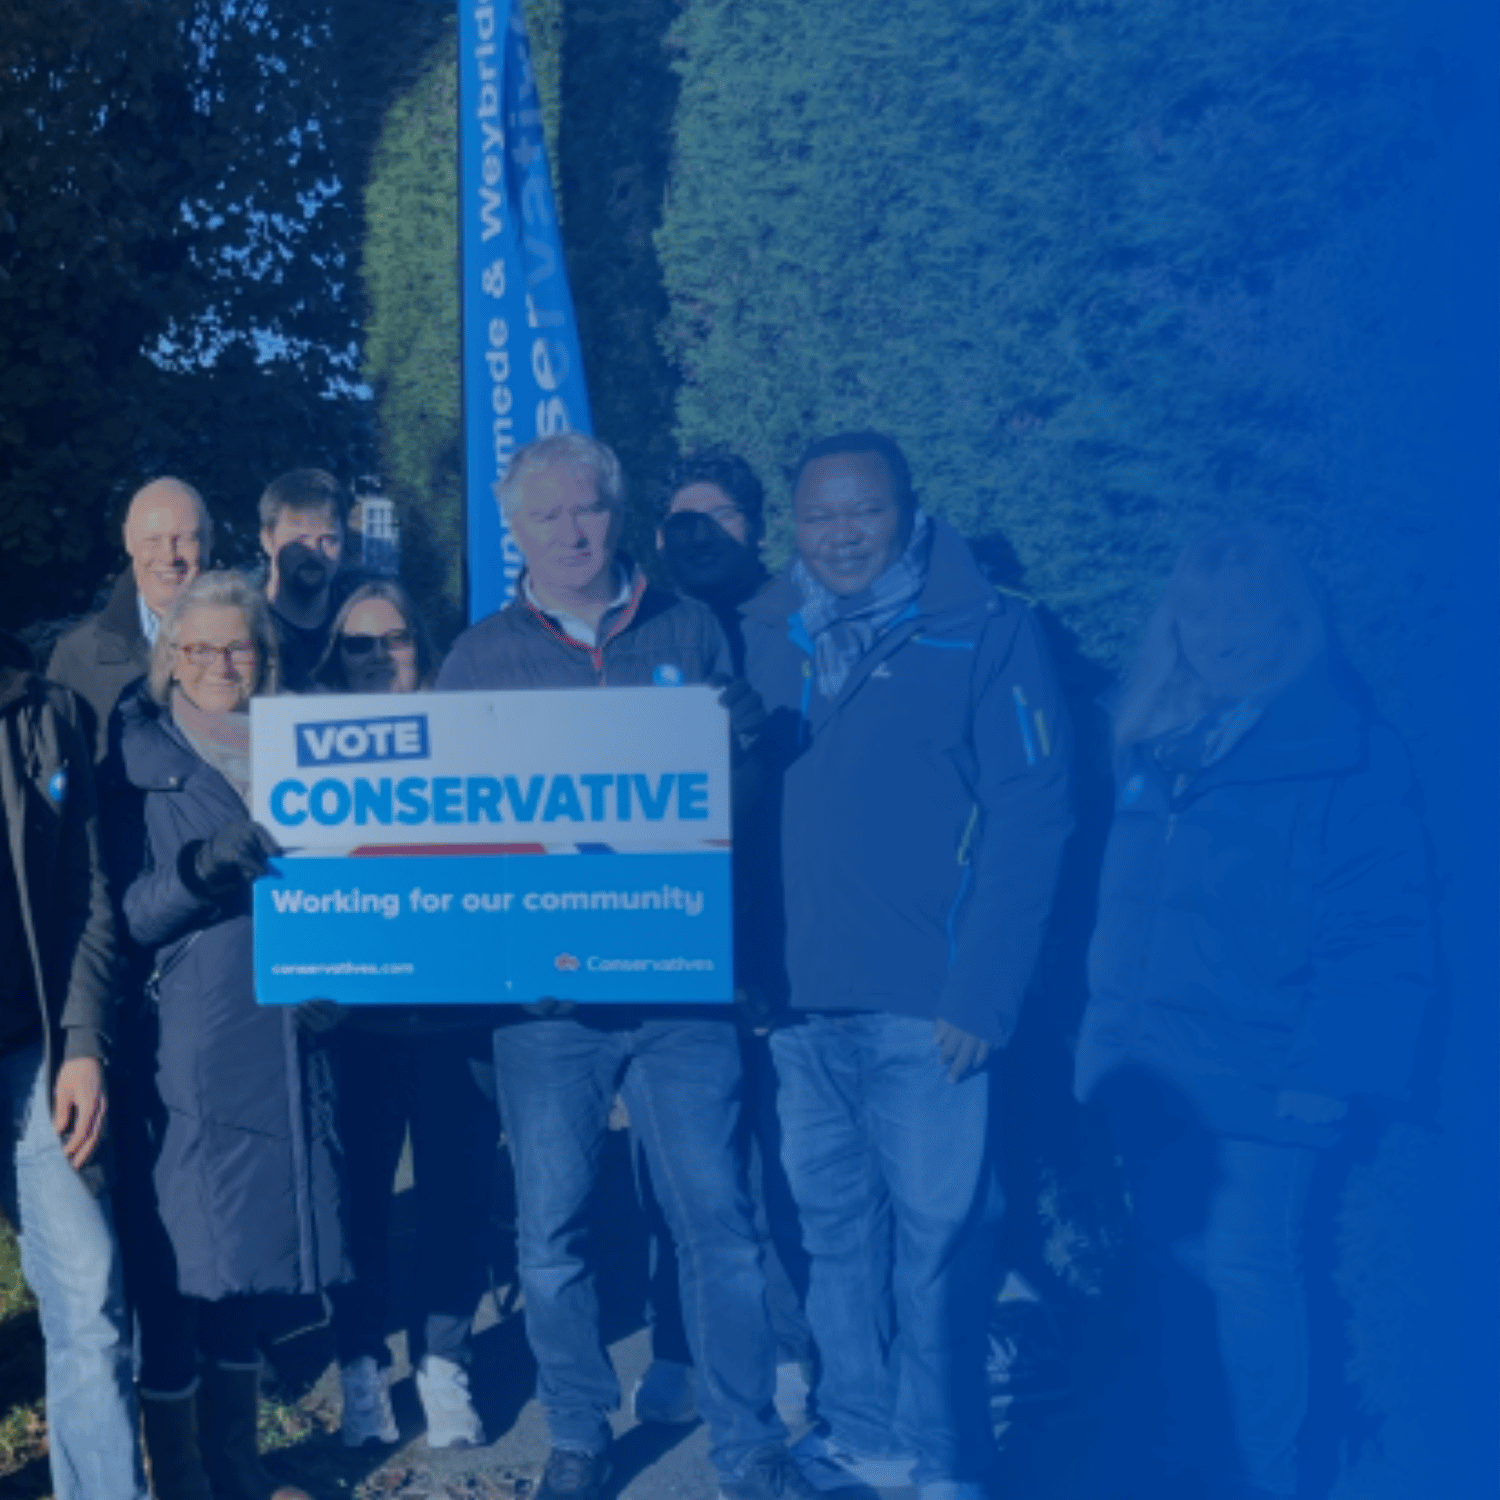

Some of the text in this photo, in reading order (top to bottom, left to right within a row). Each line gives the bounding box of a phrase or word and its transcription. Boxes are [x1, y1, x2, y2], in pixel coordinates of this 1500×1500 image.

[474, 0, 504, 243] Weybrid
[481, 258, 505, 299] &
[303, 721, 421, 760] VOTE
[269, 772, 709, 827] CONSERVATIVE
[271, 884, 705, 919] Working for our community
[586, 955, 715, 972] Conservatives
